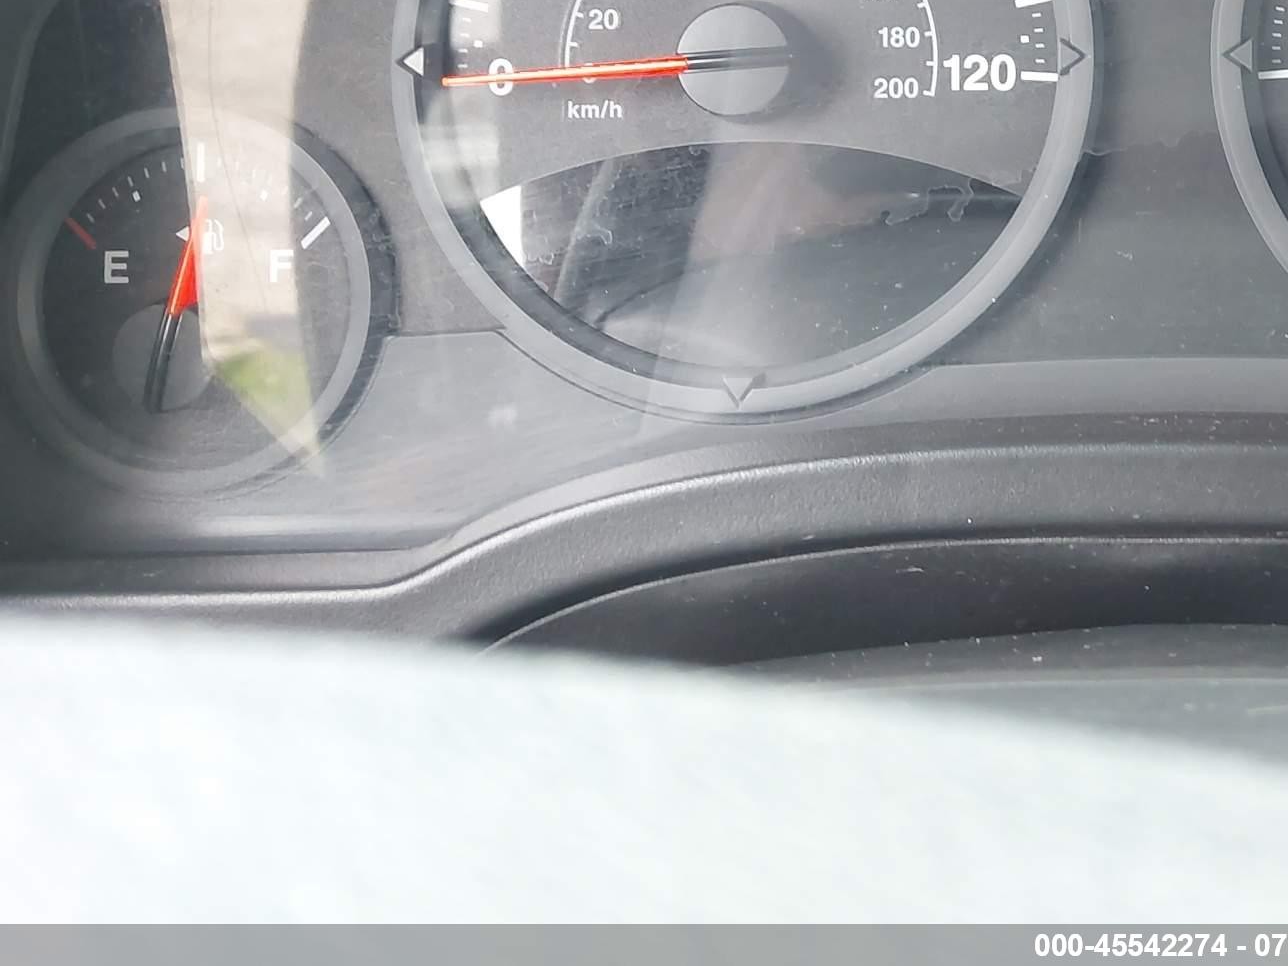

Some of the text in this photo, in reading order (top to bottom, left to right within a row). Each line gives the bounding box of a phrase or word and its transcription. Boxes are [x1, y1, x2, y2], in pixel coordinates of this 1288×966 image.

[588, 8, 621, 30] 20
[878, 26, 922, 48] 180
[488, 57, 514, 96] 0
[942, 53, 1018, 92] 120
[873, 77, 920, 100] 200
[566, 100, 624, 120] km/h
[103, 249, 130, 285] E
[268, 248, 295, 284] F
